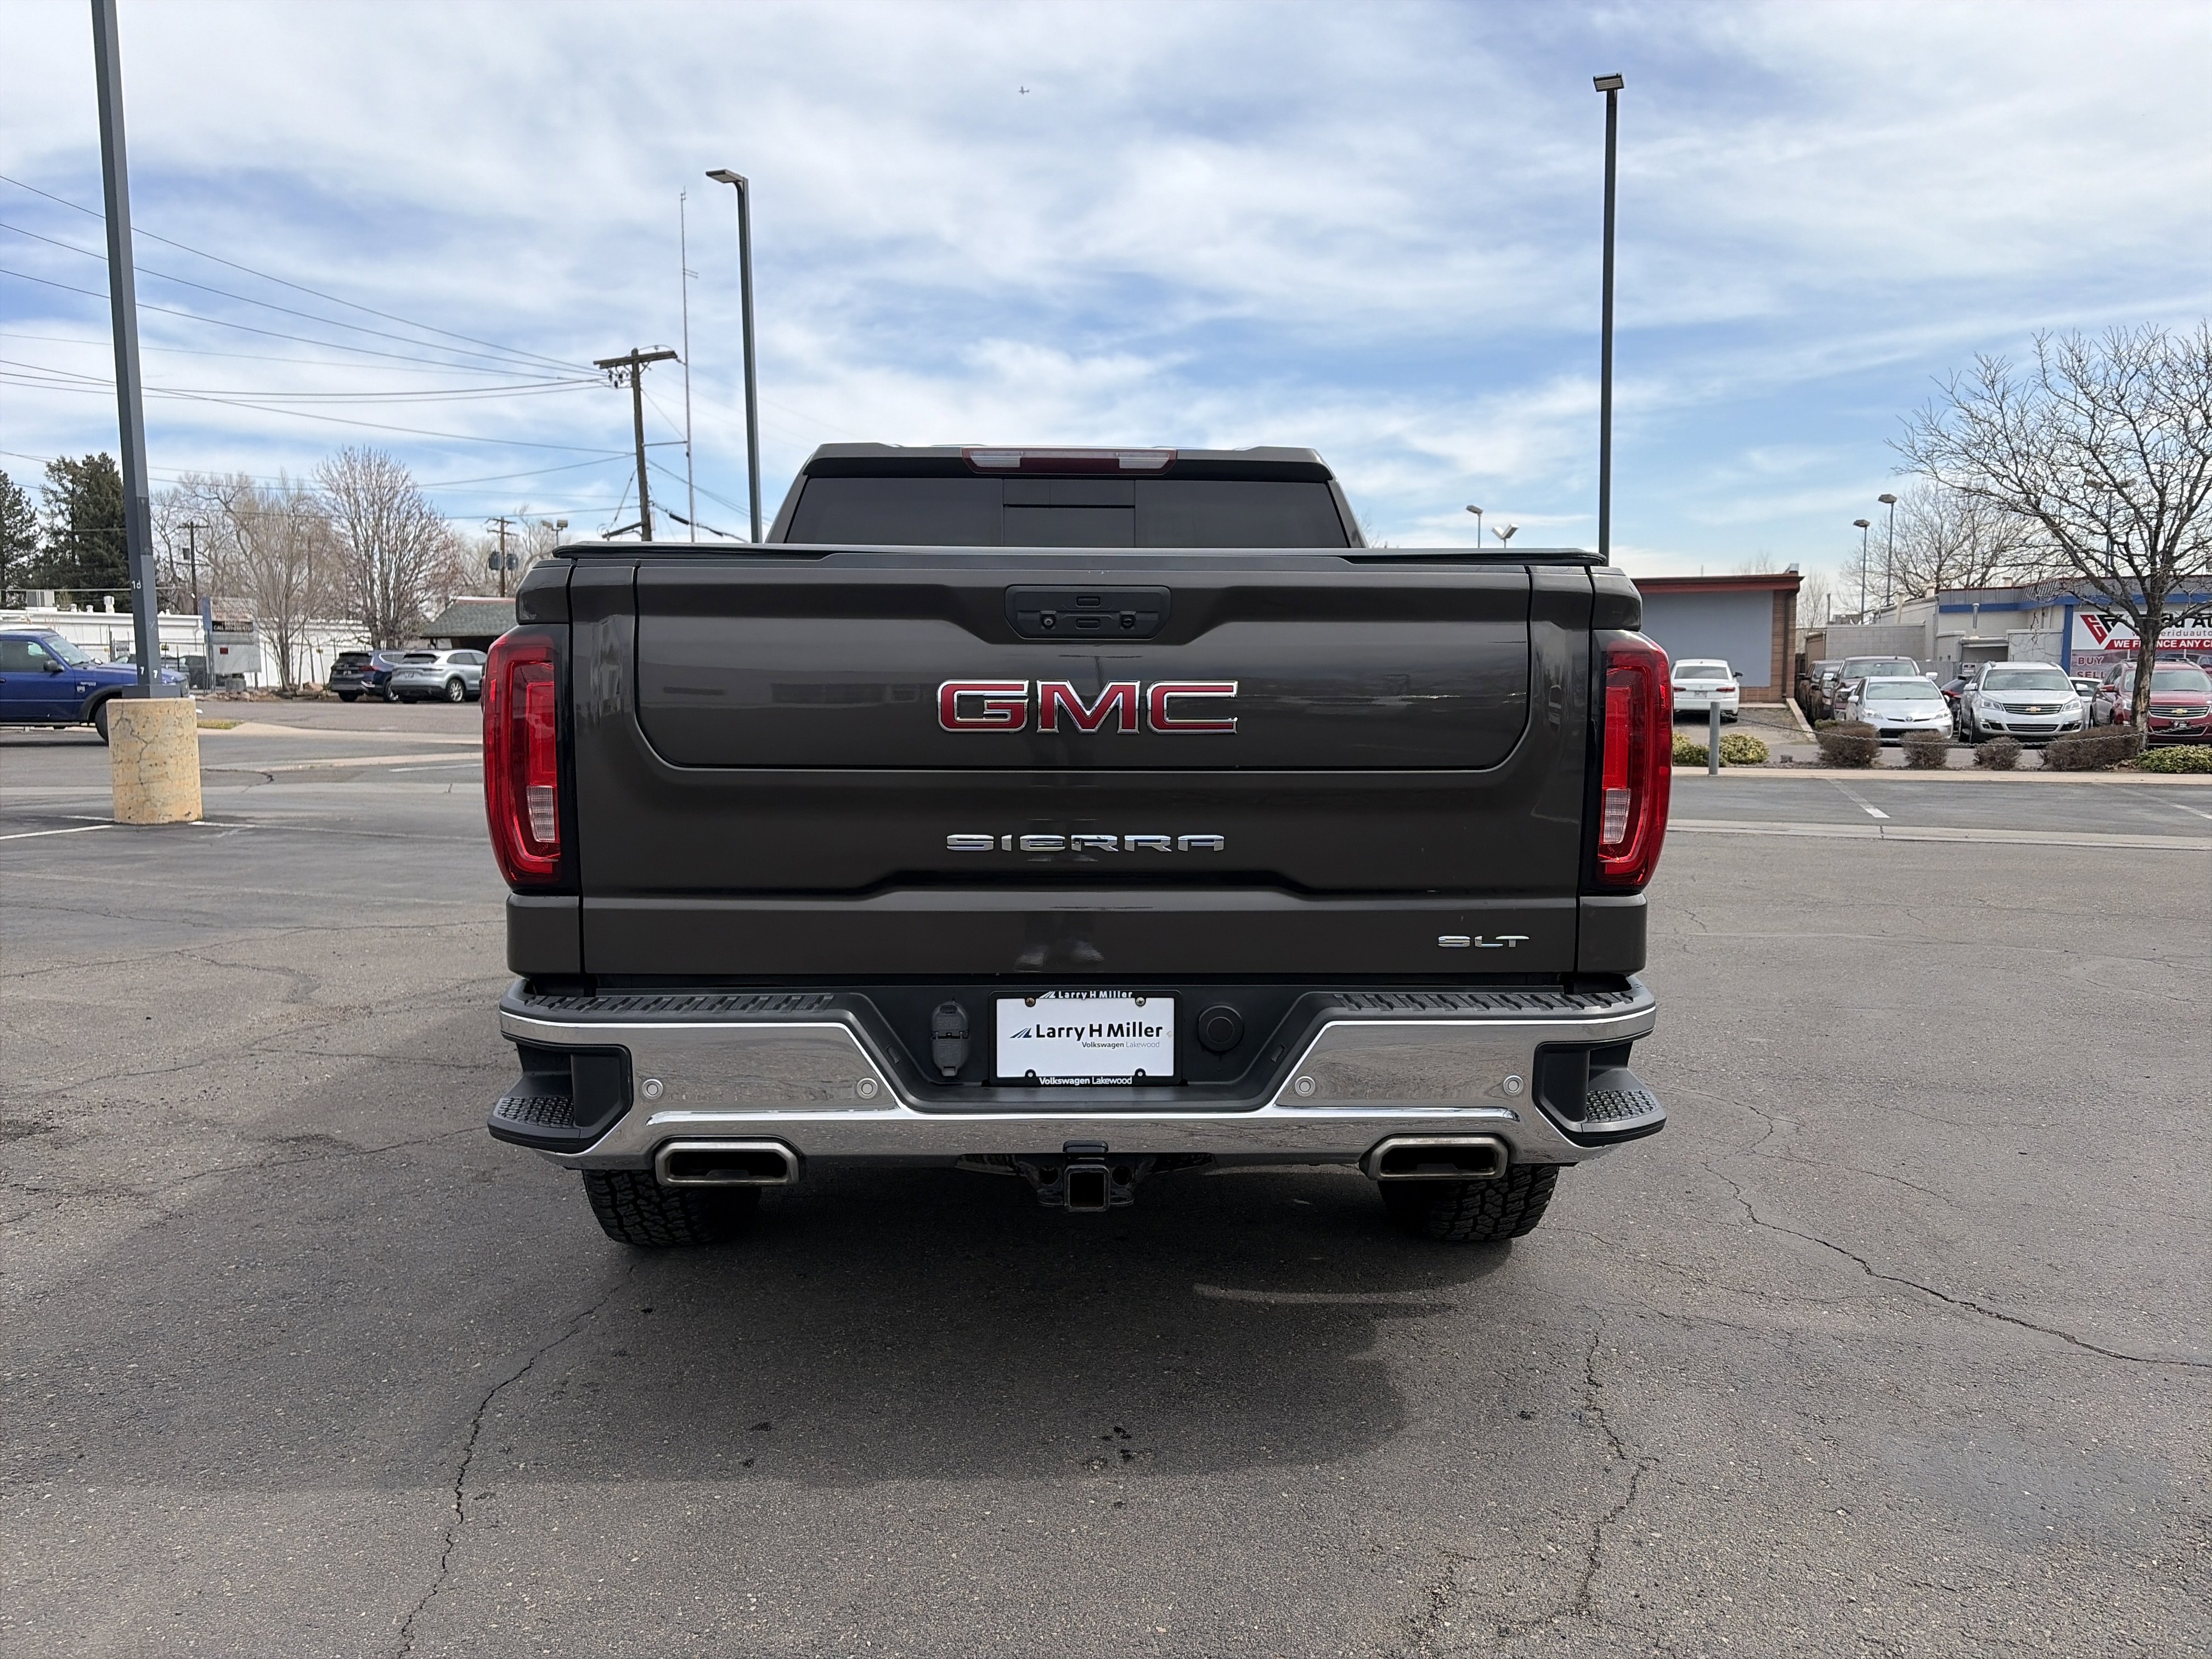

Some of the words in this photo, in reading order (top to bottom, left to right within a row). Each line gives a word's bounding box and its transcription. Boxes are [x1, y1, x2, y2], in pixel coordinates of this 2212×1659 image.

[2114, 640, 2130, 648] WE
[2132, 640, 2177, 648] FINCE
[2077, 656, 2104, 665] BUY
[937, 679, 1238, 735] GMC
[946, 834, 1225, 853] SIERRA
[1437, 935, 1530, 948] SLT
[1058, 990, 1087, 1000] Larry
[1090, 990, 1097, 998] H
[1099, 990, 1133, 998] Miller
[1036, 1024, 1086, 1041] Larry
[1089, 1023, 1103, 1038] H
[1107, 1021, 1163, 1038] Miller
[1039, 1077, 1091, 1086] Volkswagen
[1092, 1076, 1133, 1085] Lakewood
